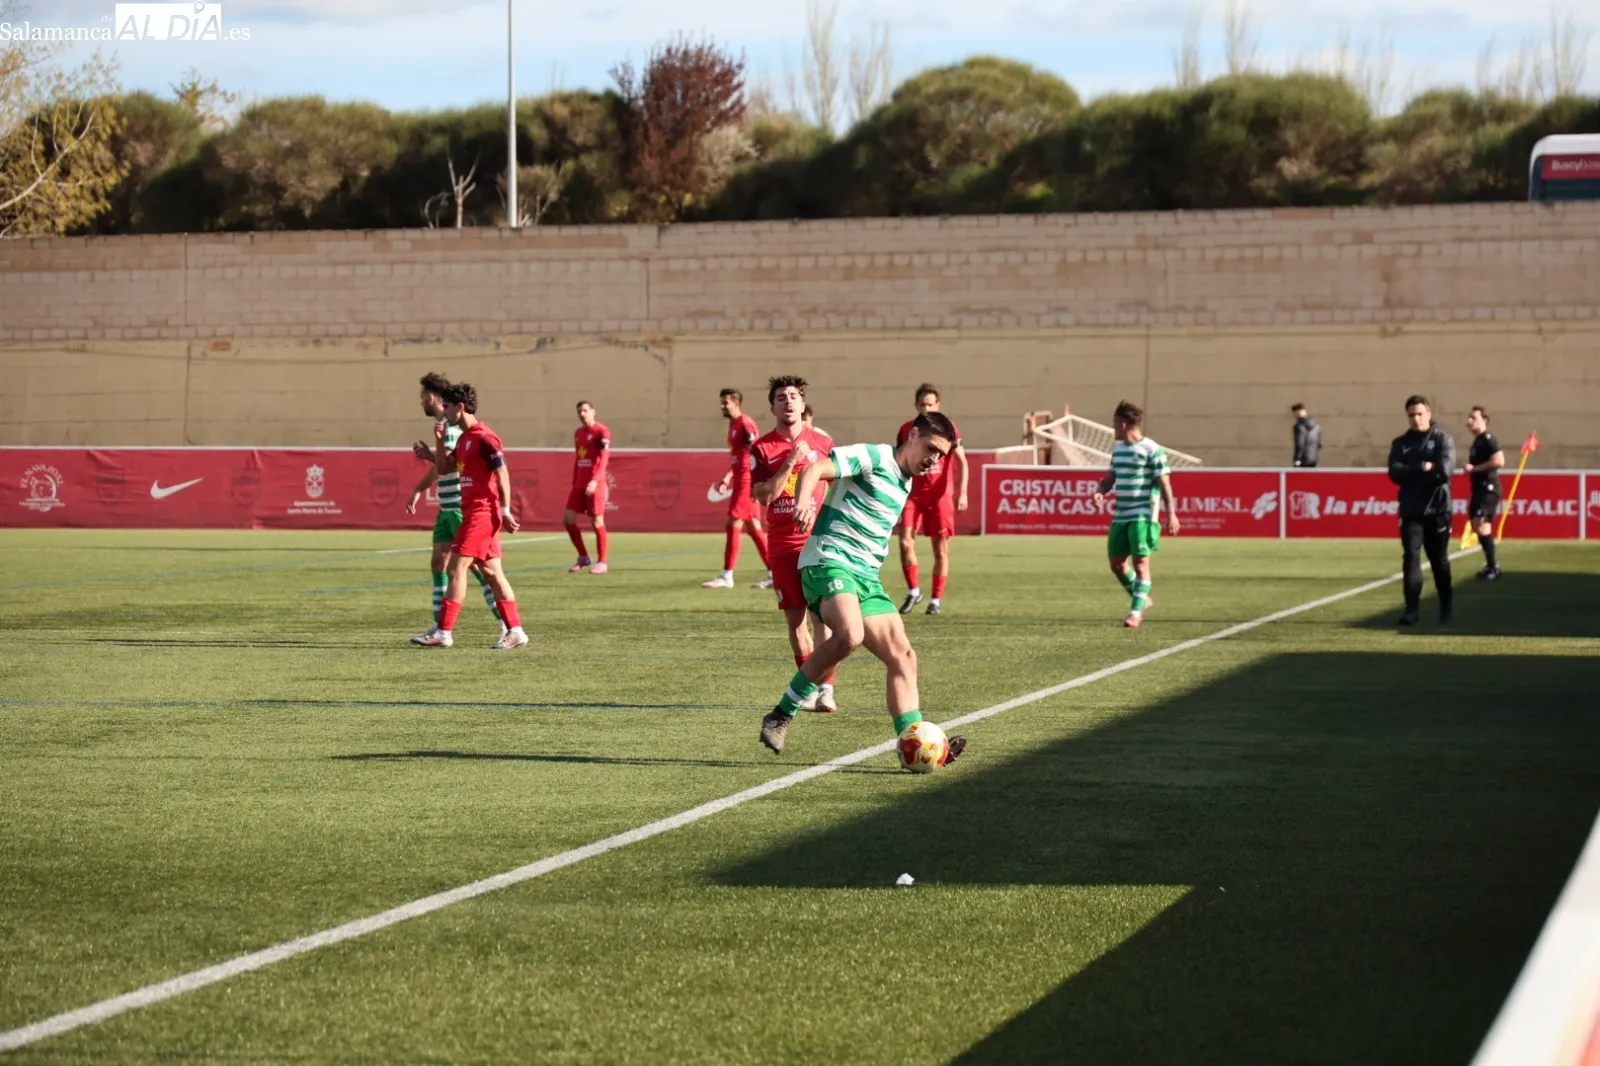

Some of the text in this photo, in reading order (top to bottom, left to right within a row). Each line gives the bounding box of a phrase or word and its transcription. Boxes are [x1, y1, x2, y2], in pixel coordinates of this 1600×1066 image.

[999, 479, 1115, 496] CRISTALER
[1058, 498, 1118, 515] CASTO
[1323, 495, 1347, 515] la
[1350, 496, 1399, 516] rive
[827, 578, 844, 593] 18
